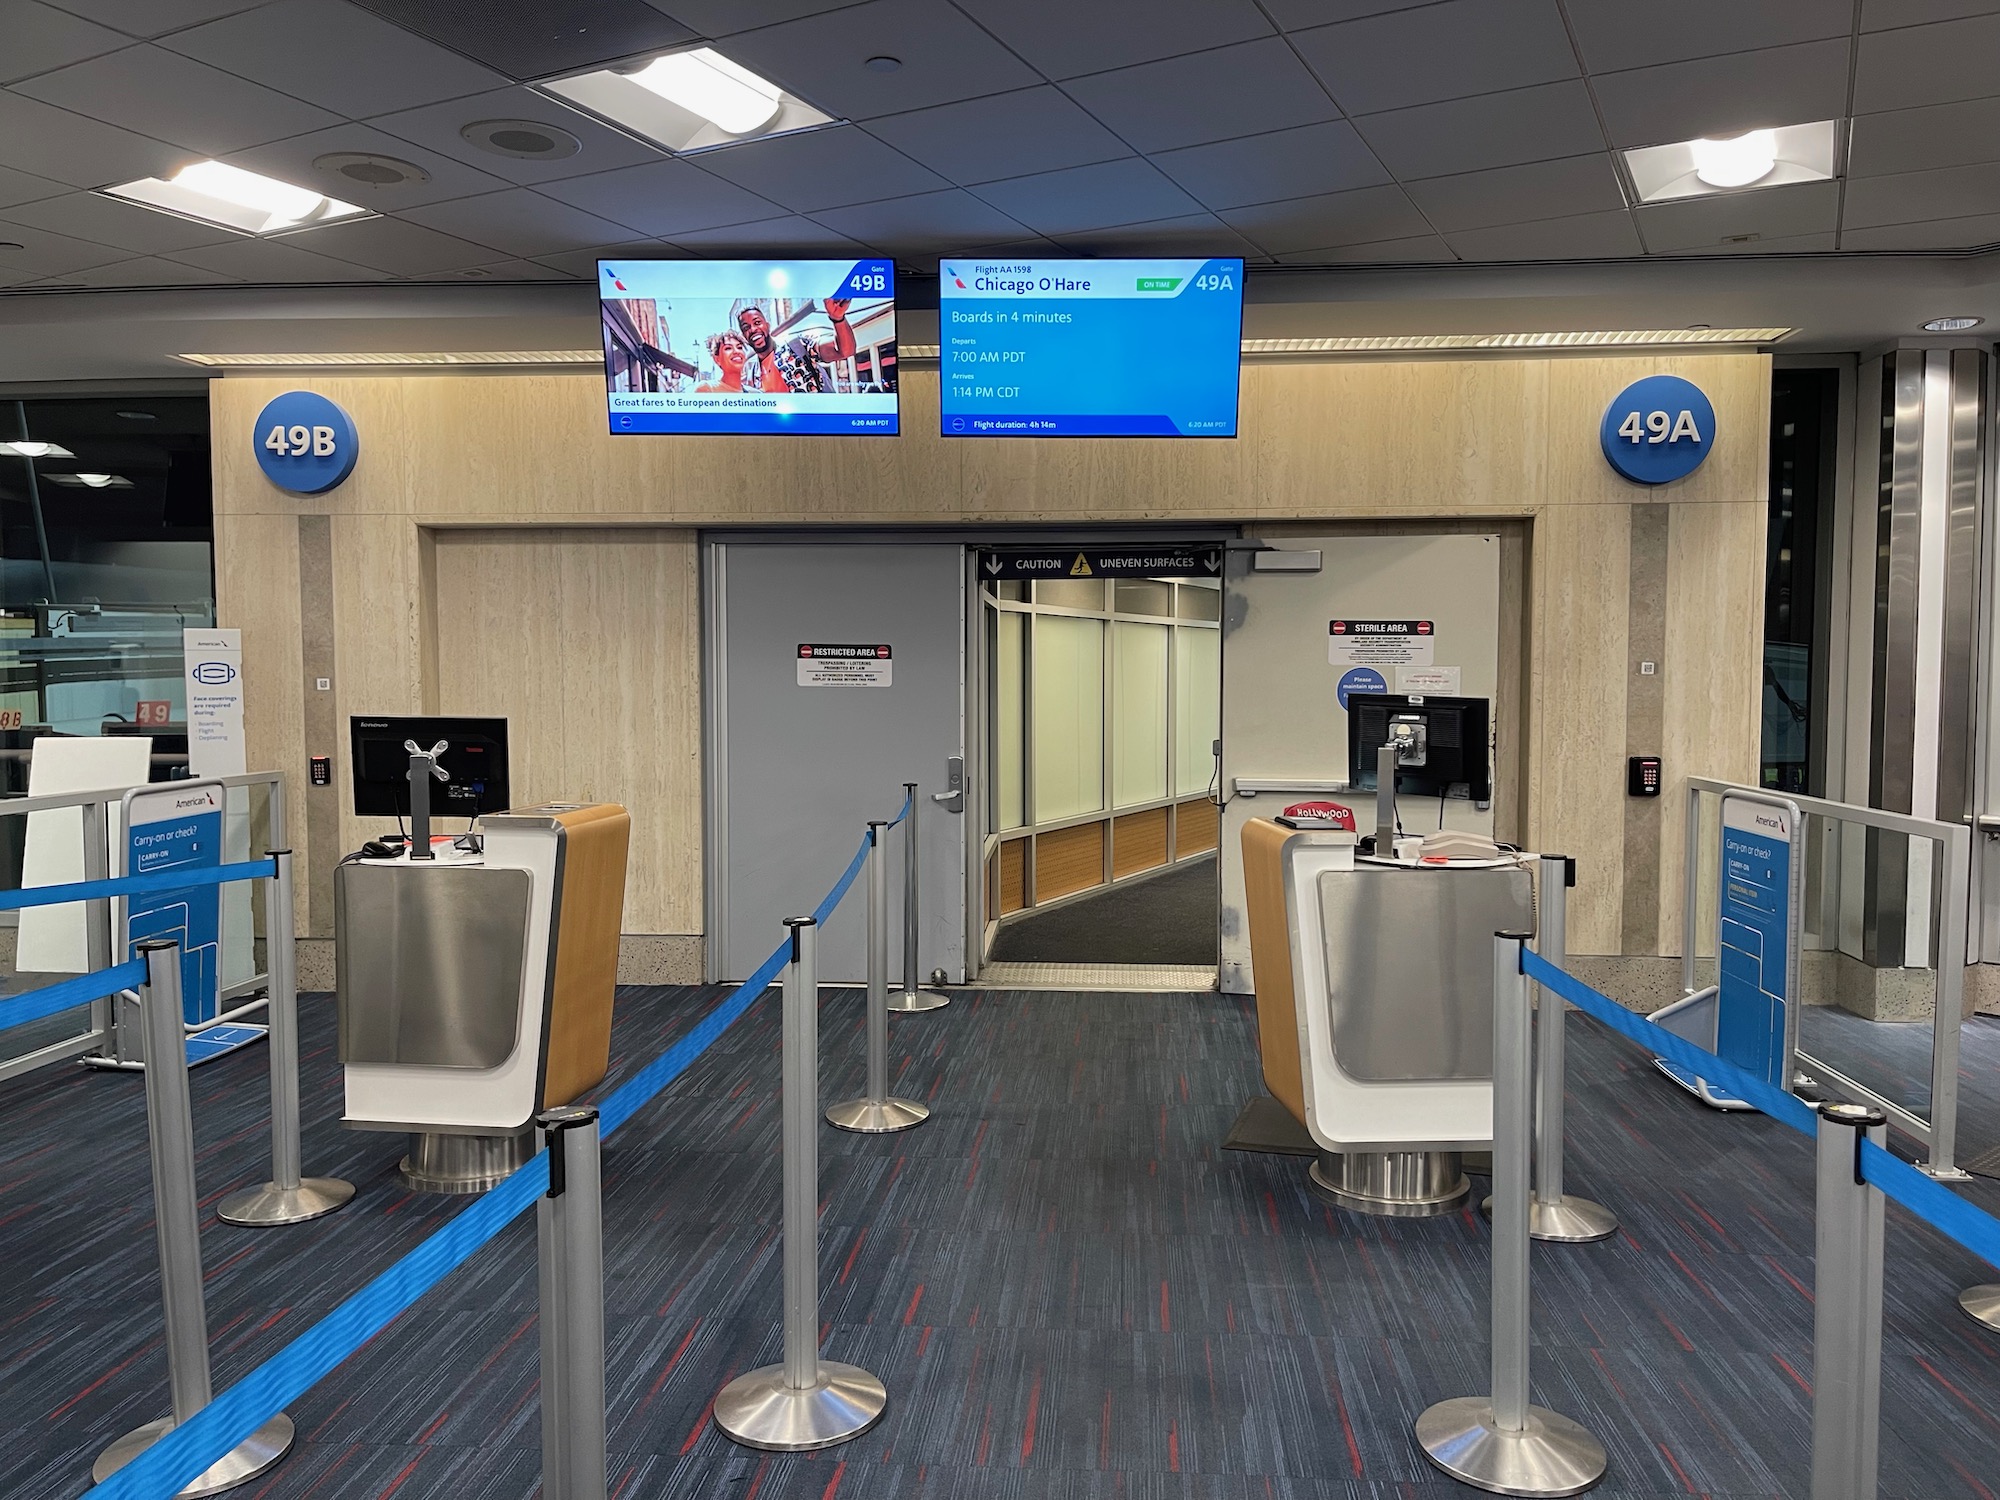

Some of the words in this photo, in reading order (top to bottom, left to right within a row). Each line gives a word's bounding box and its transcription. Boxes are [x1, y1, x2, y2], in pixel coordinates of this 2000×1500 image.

[975, 266, 998, 275] Flight
[850, 274, 886, 291] 49B
[975, 277, 1034, 294] Chicago
[1039, 278, 1091, 290] O'Hare
[1196, 274, 1234, 290] 49A
[952, 311, 994, 323] Boards
[996, 311, 1008, 323] in
[1011, 312, 1019, 322] 4
[1022, 311, 1072, 323] minutes
[952, 352, 976, 362] 7:00
[980, 352, 1000, 362] AM
[1003, 352, 1026, 362] PDT
[953, 386, 972, 398] 1:14
[976, 386, 994, 398] PM
[997, 386, 1020, 398] CDT
[614, 398, 640, 407] Great
[642, 397, 664, 407] fares
[666, 398, 676, 407] to
[678, 398, 720, 409] European
[722, 397, 777, 407] destinations
[974, 420, 994, 430] Flight
[1618, 410, 1702, 444] 49A
[265, 426, 337, 458] 49B
[1016, 559, 1062, 570] CAUTION
[1100, 558, 1142, 568] UNEVEN
[1144, 556, 1194, 568] SURFACES
[1354, 624, 1386, 632] STERILE
[1386, 624, 1408, 632] AREA
[814, 648, 856, 656] RESTRICTED
[856, 648, 876, 656] AREA
[176, 797, 206, 808] American
[1296, 808, 1350, 818] HOLLYWOOD
[1756, 814, 1778, 828] American
[134, 834, 166, 847] Carry-on
[166, 831, 174, 841] or
[175, 826, 198, 838] check?
[1726, 838, 1748, 854] Carry-on
[1748, 846, 1754, 856] or
[1754, 846, 1772, 860] check?
[141, 850, 170, 861] CARRY-ON
[1730, 860, 1750, 872] CARRY-ON
